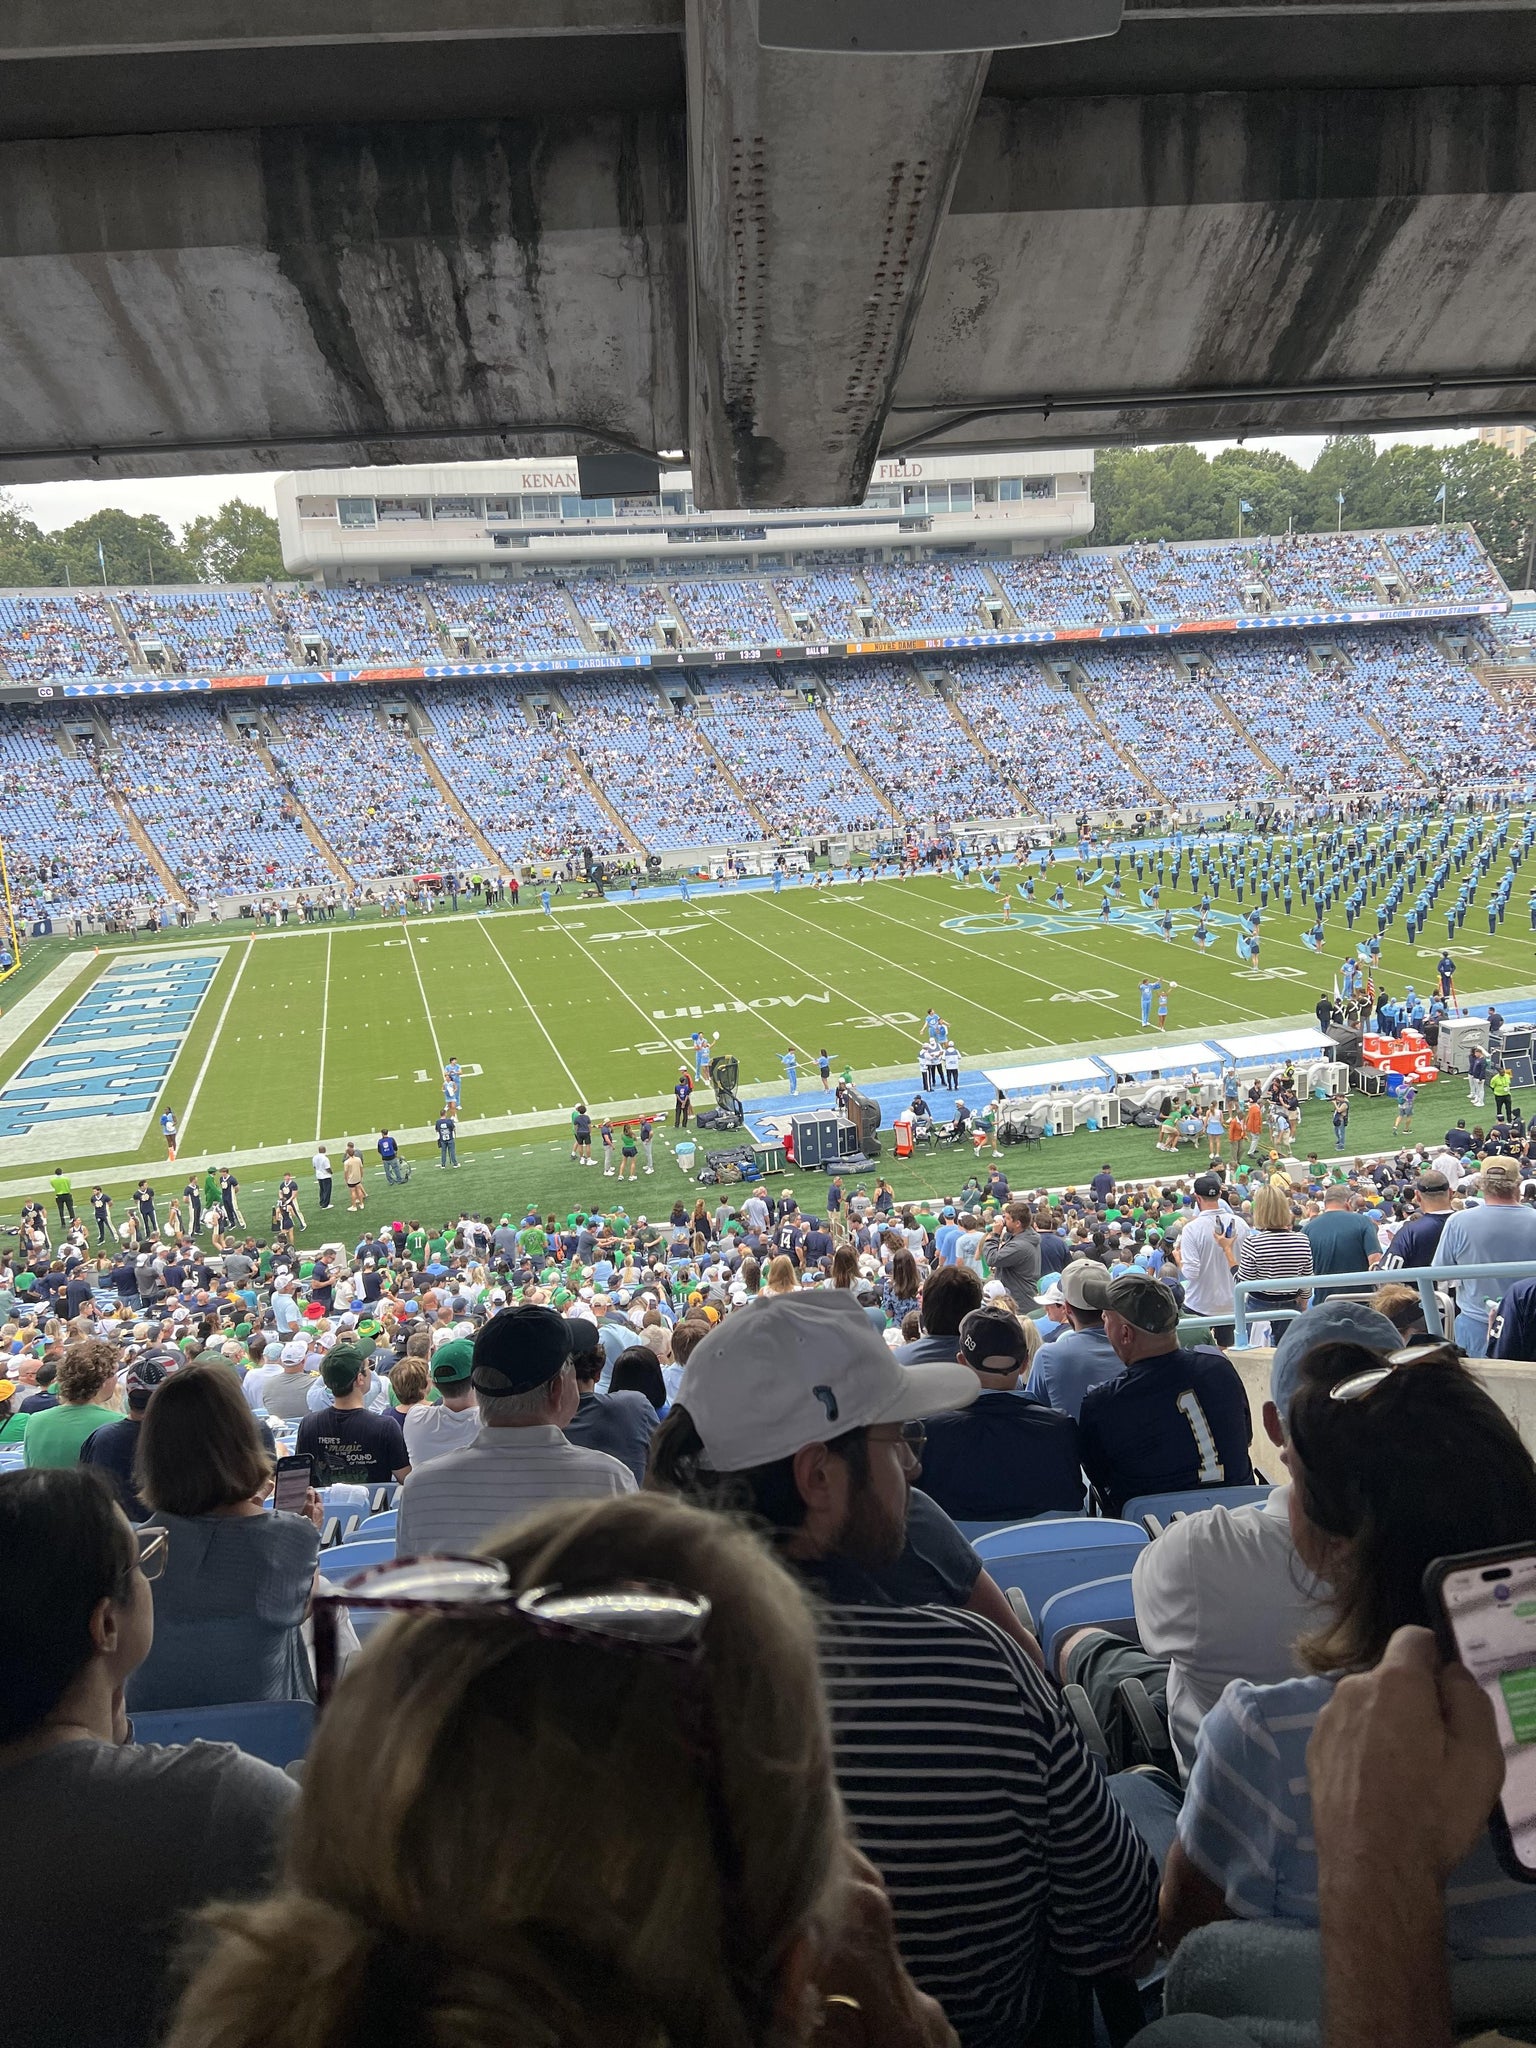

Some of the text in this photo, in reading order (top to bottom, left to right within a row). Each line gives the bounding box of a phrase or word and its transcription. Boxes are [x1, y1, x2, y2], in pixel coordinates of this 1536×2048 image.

[880, 464, 922, 478] FIELD
[521, 474, 577, 488] KENAN
[1379, 606, 1480, 619] WELCOME TO KENAN STADIUM
[874, 641, 897, 651] NOTRE
[898, 640, 917, 649] DAME
[714, 652, 726, 661] 1ST
[739, 650, 761, 660] 13:39
[578, 657, 622, 668] CAROLINA
[40, 688, 52, 696] CC
[1230, 966, 1308, 981] 50
[1049, 988, 1120, 1003] 40
[651, 990, 831, 1019] Motrin
[845, 1012, 922, 1029] 30
[1414, 1055, 1426, 1068] G
[1495, 1145, 1502, 1156] 7
[1509, 1144, 1521, 1155] 26
[414, 1236, 423, 1249] 11
[780, 1232, 792, 1250] 14
[1381, 1252, 1405, 1271] 10
[191, 1271, 200, 1287] 5
[1176, 1389, 1224, 1483] 1
[329, 1441, 362, 1454] magic
